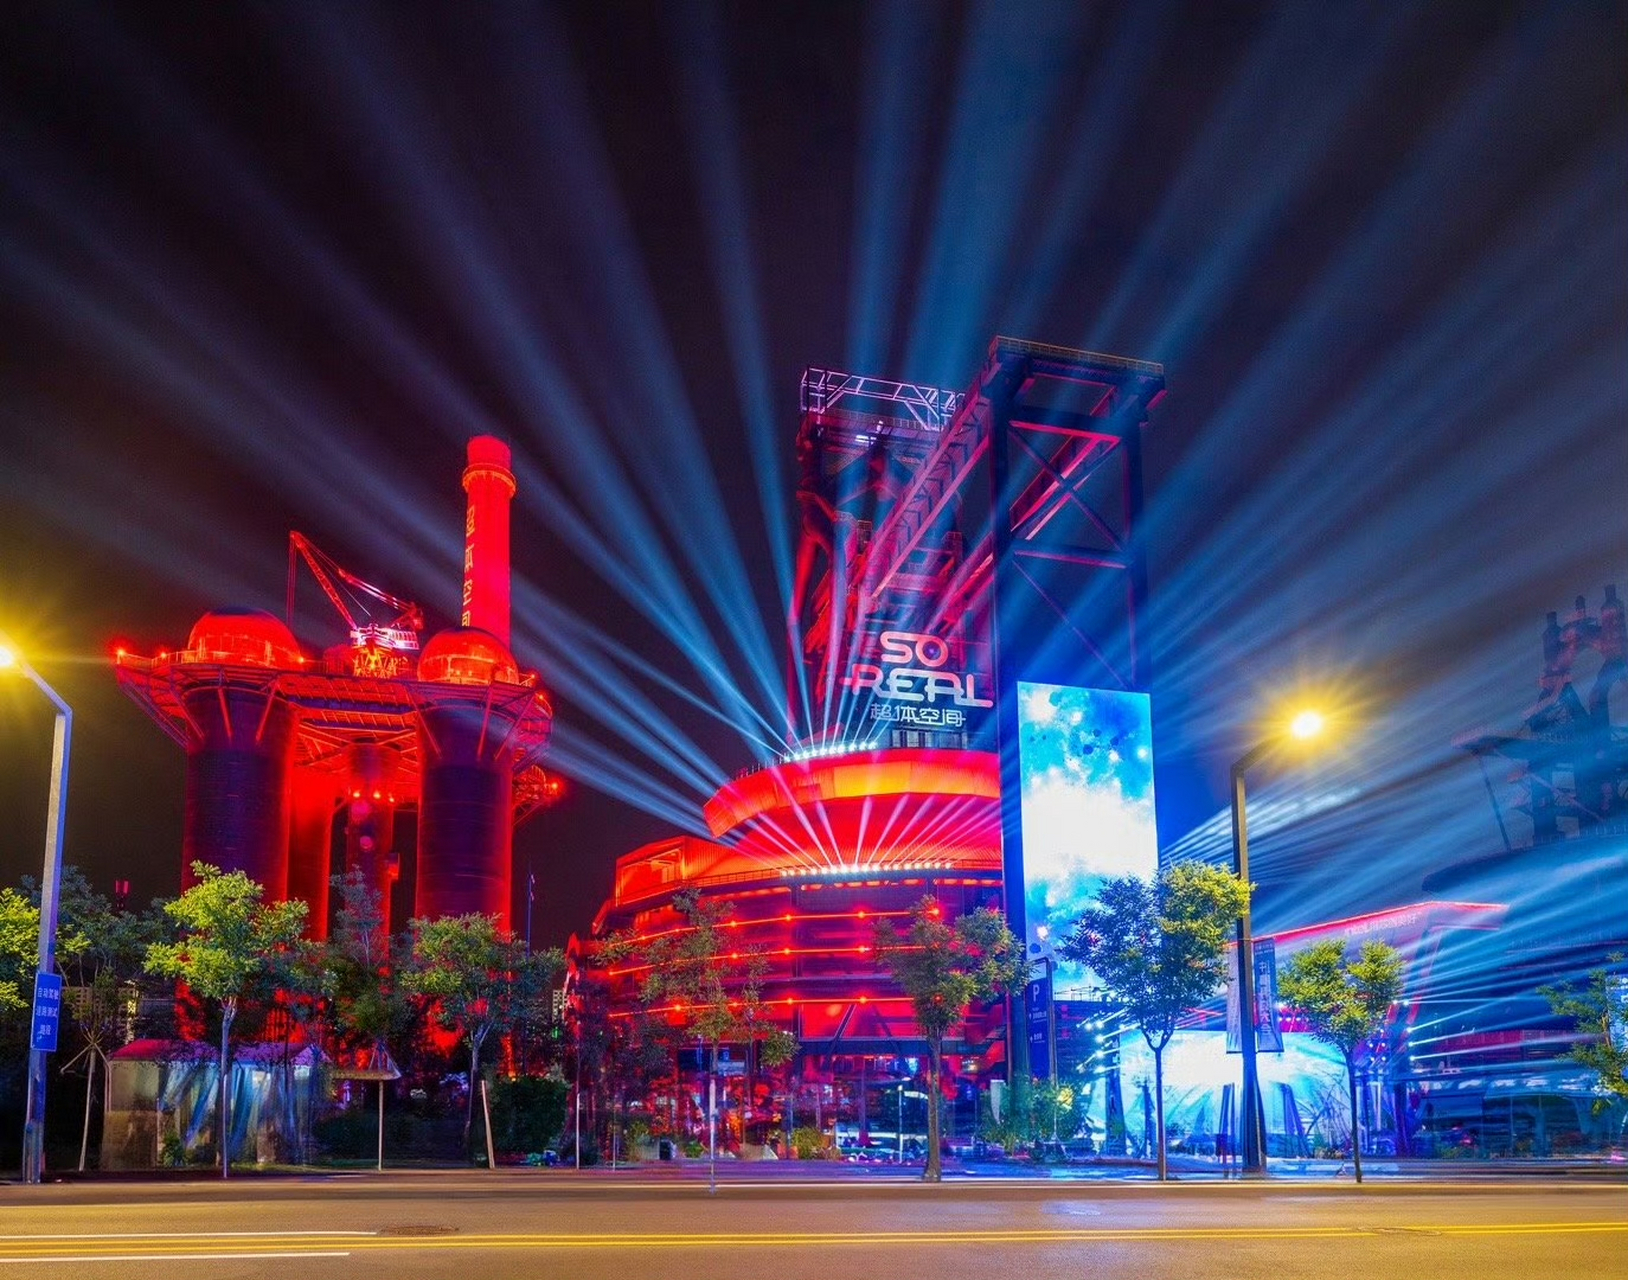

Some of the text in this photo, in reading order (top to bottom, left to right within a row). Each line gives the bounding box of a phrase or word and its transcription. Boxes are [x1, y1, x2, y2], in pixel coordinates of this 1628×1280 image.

[880, 631, 949, 667] SO
[840, 663, 994, 708] REAL
[870, 702, 967, 728] 超体空间
[1032, 984, 1040, 1002] P
